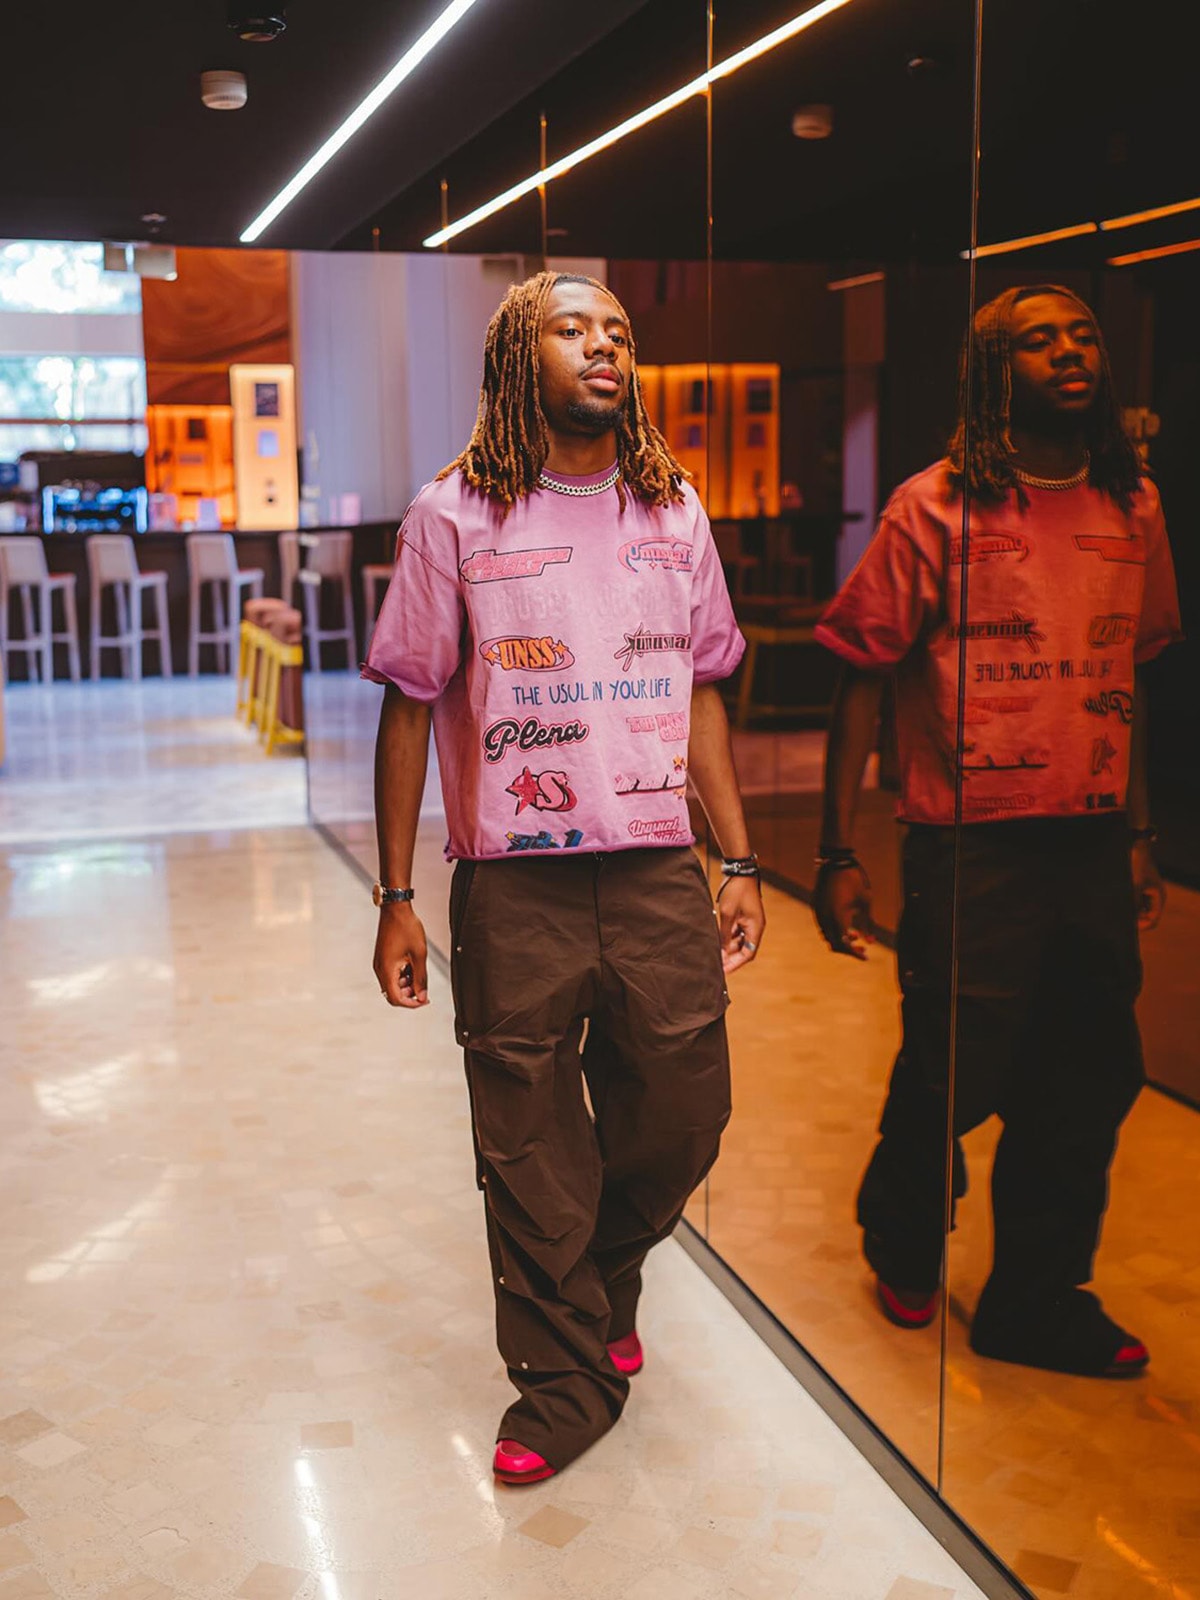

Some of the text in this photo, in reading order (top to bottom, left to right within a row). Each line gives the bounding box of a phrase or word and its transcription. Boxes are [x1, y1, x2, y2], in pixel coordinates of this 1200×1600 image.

[498, 636, 555, 670] UNSS
[512, 686, 543, 706] THE
[548, 682, 590, 704] USUL
[609, 679, 648, 701] YOUR
[483, 717, 589, 764] Plena
